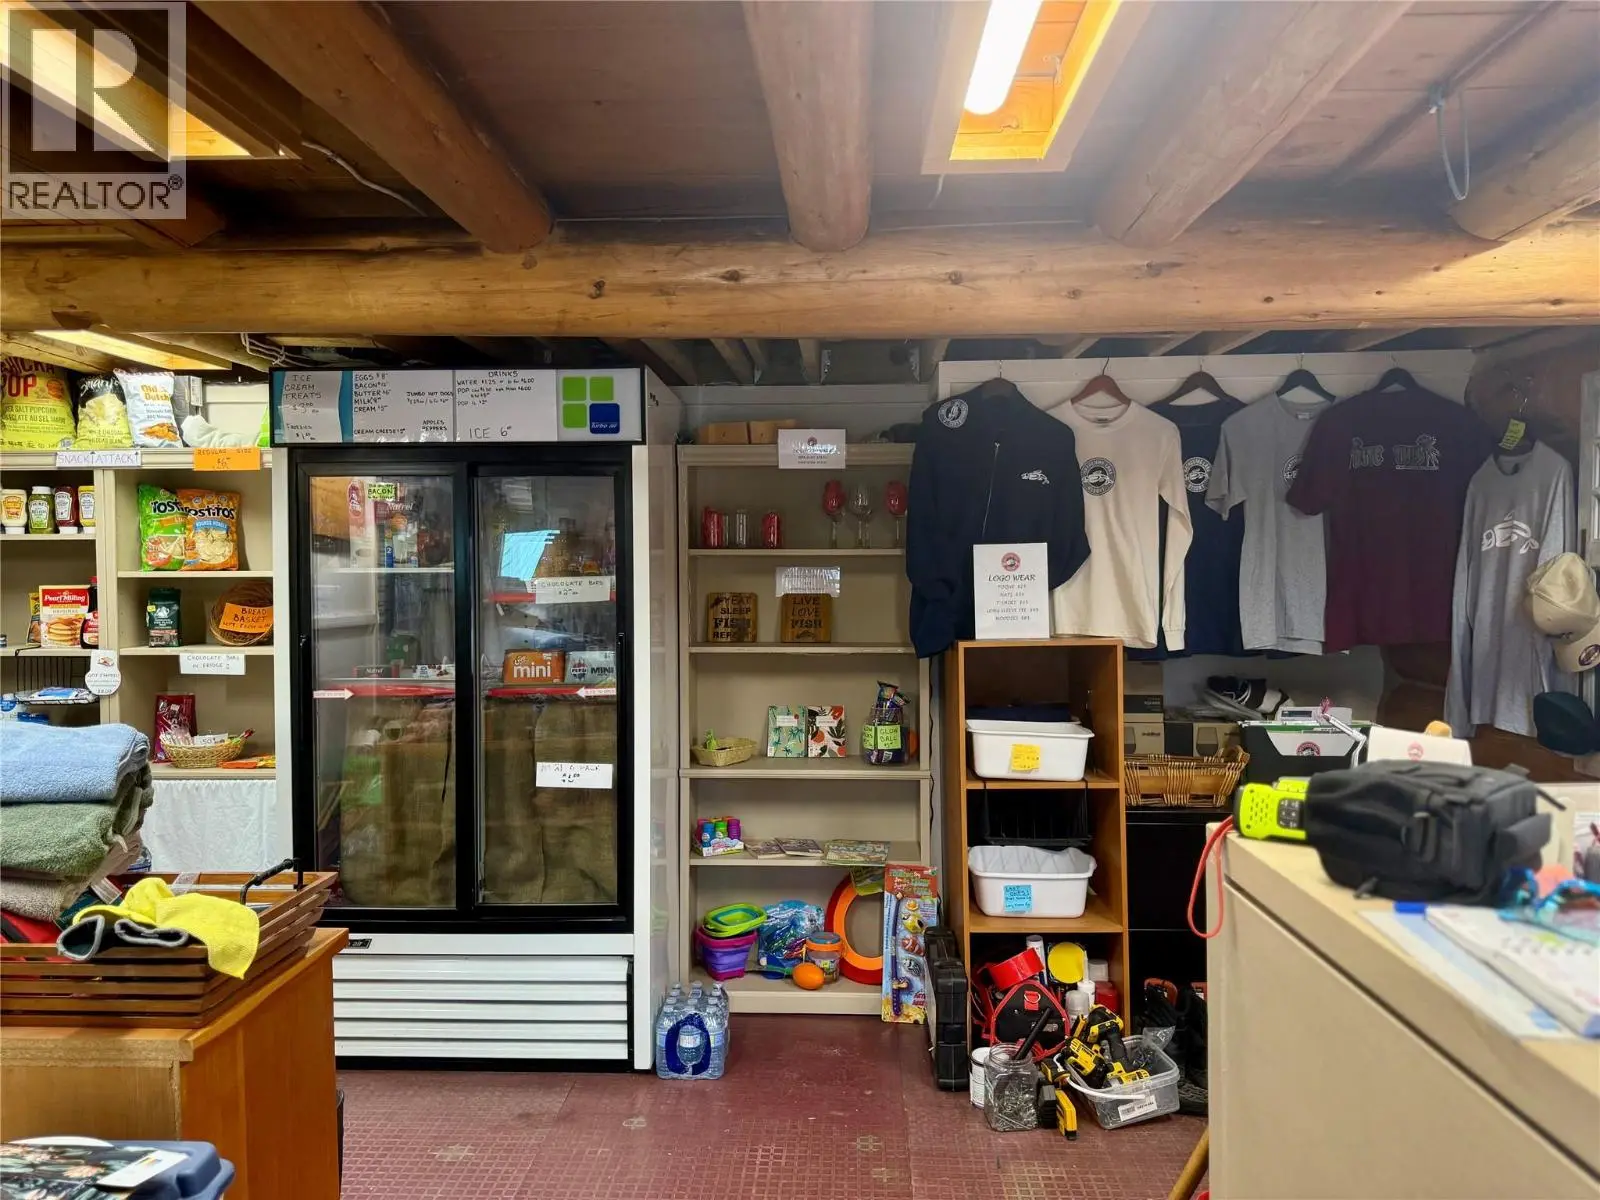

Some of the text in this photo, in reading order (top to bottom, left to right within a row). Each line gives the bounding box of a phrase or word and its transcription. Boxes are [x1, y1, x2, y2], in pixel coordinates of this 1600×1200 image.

[469, 427, 491, 439] ICE
[988, 574, 1011, 582] LOGO
[44, 594, 86, 603] Pearl Milling
[792, 594, 821, 605] LIVE
[720, 607, 751, 615] SLEEP
[791, 608, 821, 617] LOVE
[233, 614, 265, 623] BASKET
[791, 619, 822, 629] FISH
[513, 661, 552, 678] mini
[590, 667, 615, 675] MINI
